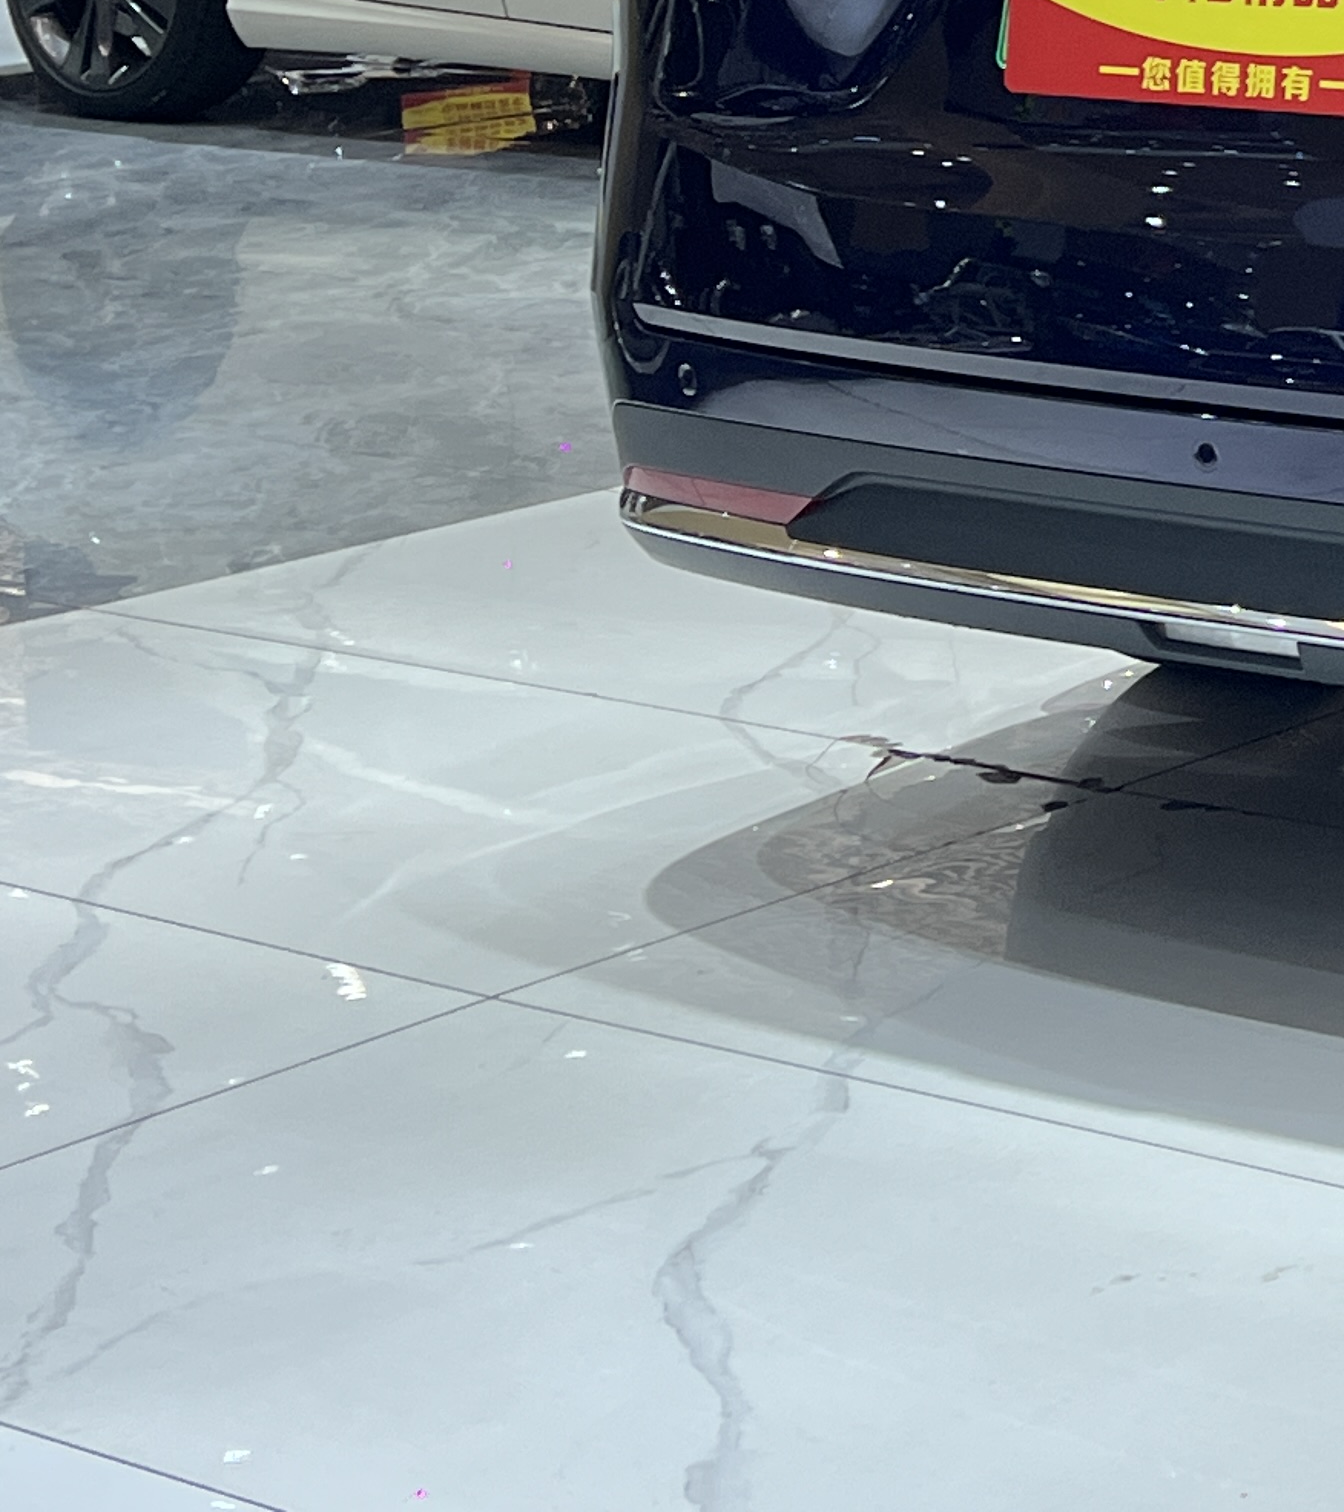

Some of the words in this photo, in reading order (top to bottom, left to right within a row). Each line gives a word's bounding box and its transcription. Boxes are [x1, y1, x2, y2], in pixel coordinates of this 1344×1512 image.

[1142, 56, 1314, 102] 您值得拥有
